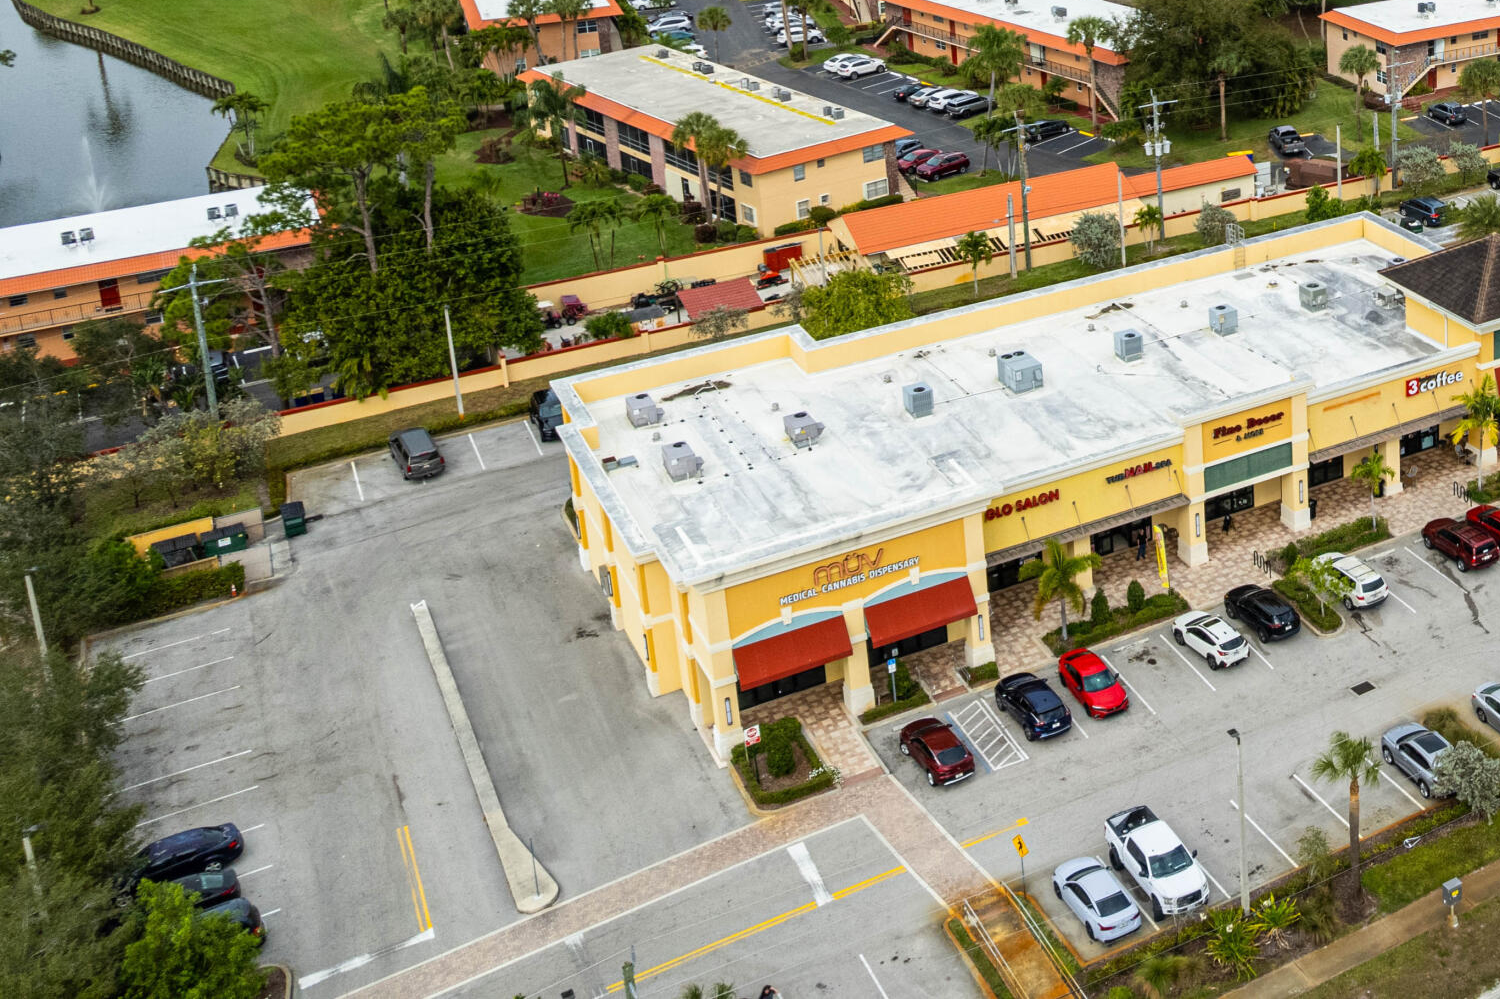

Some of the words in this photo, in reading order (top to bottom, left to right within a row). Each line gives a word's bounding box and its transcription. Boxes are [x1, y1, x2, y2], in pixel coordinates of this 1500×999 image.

[1408, 380, 1418, 395] 3
[1420, 370, 1464, 393] coffee
[1124, 461, 1156, 479] NAIL
[1015, 488, 1060, 512] SALON
[779, 587, 819, 606] MEDICAL
[821, 573, 867, 594] CANNABIS
[868, 555, 921, 580] DISPENSARY
